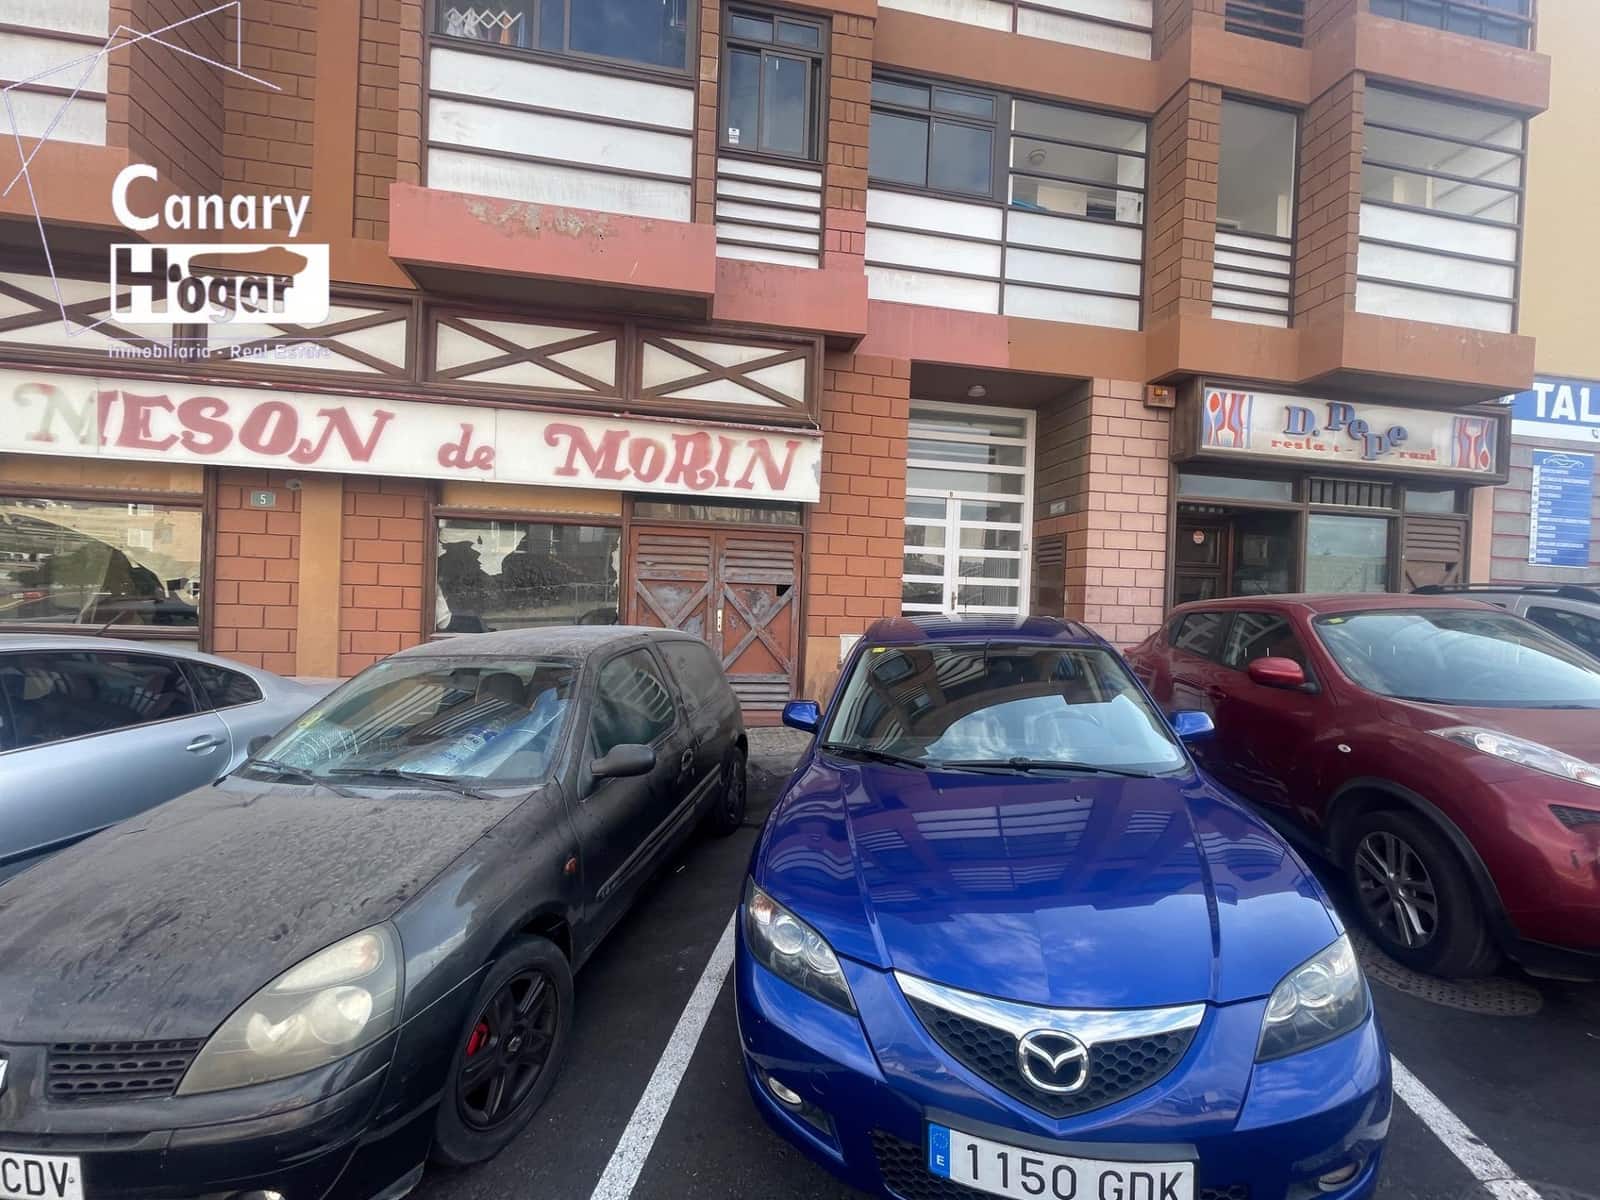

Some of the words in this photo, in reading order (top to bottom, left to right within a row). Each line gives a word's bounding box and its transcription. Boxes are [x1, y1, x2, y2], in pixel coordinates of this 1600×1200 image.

[1532, 382, 1600, 423] TAL
[13, 382, 395, 464] MESON
[437, 423, 496, 471] de
[543, 423, 803, 491] MORIN
[259, 494, 267, 505] 5
[1, 1158, 69, 1198] CDV
[936, 1155, 945, 1167] E
[967, 1144, 1077, 1200] 1150
[1098, 1170, 1183, 1200] GDK
